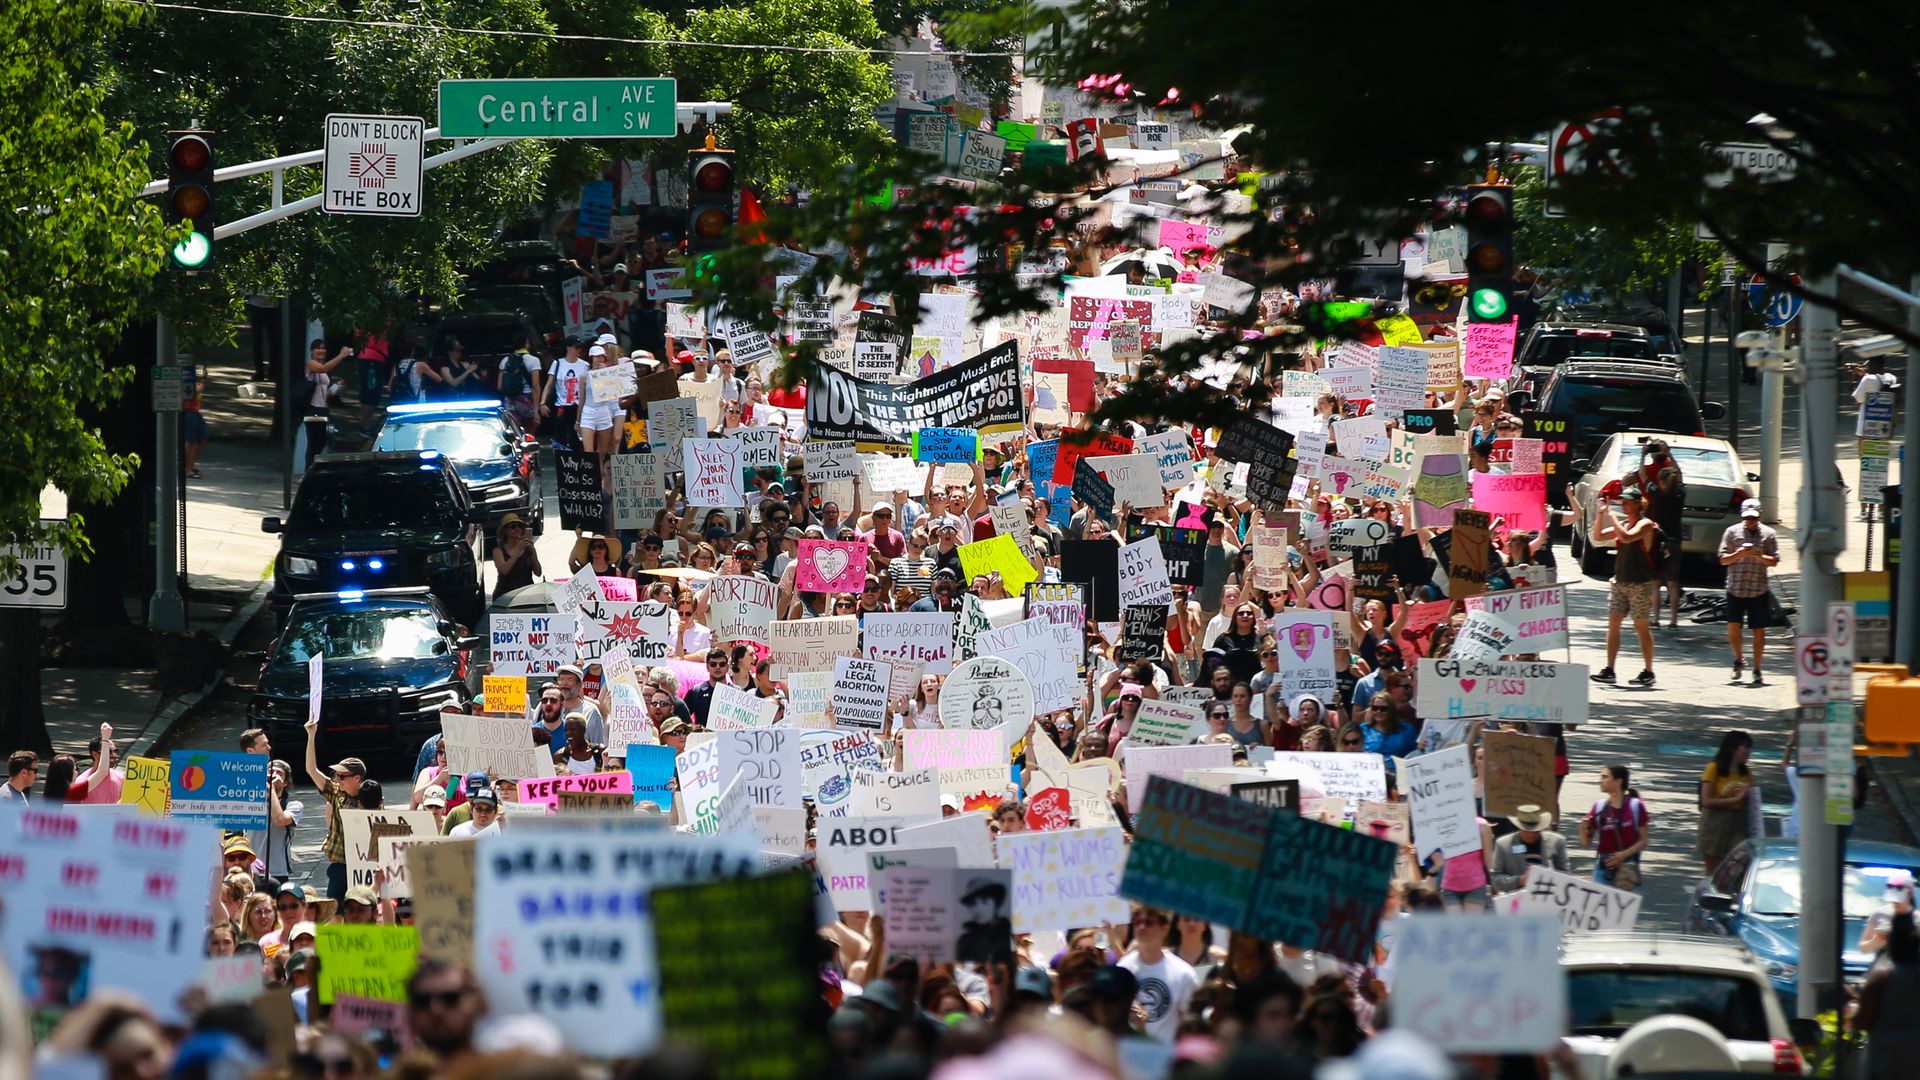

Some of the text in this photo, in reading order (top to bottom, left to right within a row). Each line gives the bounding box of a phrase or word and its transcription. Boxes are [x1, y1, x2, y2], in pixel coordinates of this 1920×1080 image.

[621, 85, 655, 104] AVE
[478, 94, 598, 124] Central
[624, 112, 651, 131] SW
[331, 121, 418, 141] DON'T BLOCK
[1141, 125, 1168, 133] DEFEND
[968, 131, 983, 144] WE
[1148, 133, 1162, 142] ROE
[970, 144, 1001, 160] SHALL
[332, 189, 412, 210] THE BOX
[1132, 190, 1145, 198] NO
[1086, 299, 1134, 309] SUGAR
[1162, 297, 1185, 308] Body
[812, 311, 829, 319] WON
[1085, 311, 1128, 319] SPICE
[734, 333, 765, 349] FIGHT FOR
[735, 340, 770, 357] SOCIALISM!
[824, 350, 845, 360] BODY
[858, 360, 894, 368] IS SEXIST!
[861, 353, 892, 361] SYSTEM
[859, 372, 878, 380] FIGHT
[865, 388, 888, 402] This
[892, 377, 958, 405] Nightmare
[960, 364, 988, 384] Must
[990, 349, 1014, 370] End:
[866, 369, 1017, 420] THE TRUMP/PENCE
[1346, 386, 1363, 394] LEGAL
[941, 388, 1015, 426] MUST GO!
[989, 411, 1020, 423] America!
[1407, 415, 1433, 426] PRO
[825, 427, 855, 439] Name of
[943, 429, 973, 437] KEMP
[1534, 420, 1566, 432] YOU
[732, 429, 779, 445] TRUST
[806, 443, 824, 453] KEEP
[561, 457, 594, 472] Why Are
[616, 455, 656, 465] WE NEED
[701, 454, 724, 464] KEEP
[625, 466, 634, 476] GET
[704, 464, 727, 473] YOUR
[807, 470, 856, 480] SAFE LEGAL
[1110, 466, 1130, 481] NOT
[563, 472, 594, 485] You So
[1161, 470, 1184, 483] RIGHTS
[559, 489, 601, 500] Obsessed
[564, 503, 602, 518] With Us?
[995, 507, 1015, 519] WE
[1456, 511, 1489, 530] NEVER
[10, 547, 54, 560] LIMIT
[1120, 546, 1141, 562] MY
[1362, 547, 1379, 561] MY
[1120, 557, 1152, 579] BODY
[1452, 565, 1487, 584] AGAIN
[4, 565, 57, 596] 35
[1361, 575, 1382, 586] MY
[711, 577, 775, 610] ABORTION
[1031, 584, 1078, 602] KEEP
[1122, 579, 1170, 603] POLITICAL
[738, 603, 748, 614] IS
[1492, 590, 1560, 613] MY FUTURE
[583, 601, 610, 620] We
[1128, 607, 1162, 621] TRANS
[532, 618, 550, 632] MY
[720, 617, 769, 641] healthcare
[775, 621, 852, 638] HEARTBEAT BILLS
[867, 623, 949, 637] KEEP ABORTION
[1125, 621, 1148, 635] MEN
[1518, 617, 1568, 638] CHOICE
[493, 632, 549, 645] BODY, NOT
[493, 650, 535, 662] POLITICAL
[607, 659, 629, 680] RIGHTS
[849, 661, 876, 672] SAFE,
[1296, 668, 1329, 678] ARE YOU
[1435, 661, 1556, 679] GA LAWMAKERS
[845, 671, 876, 682] LEGAL
[485, 685, 512, 693] PRIVACY
[834, 679, 885, 694] ABORTION
[1486, 679, 1526, 695] PUSSY
[486, 697, 507, 705] BODILY
[792, 687, 827, 701] MIGRANT
[833, 695, 883, 707] ON DEMAND
[721, 689, 764, 714] OUR BODIES
[717, 702, 760, 726] OUR MINDS
[843, 707, 882, 719] APOLOGIES!
[1155, 707, 1194, 720] Pro Choice
[479, 720, 530, 749] BODY
[735, 730, 785, 755] STOP
[801, 730, 871, 762] IS IT REALLY
[907, 731, 962, 753] GIRLS
[474, 747, 538, 778] CHOICE
[804, 742, 878, 770] about FETUSES
[126, 760, 166, 781] BUILD
[220, 761, 263, 772] Welcome
[738, 759, 782, 781] OLD
[237, 777, 246, 785] to
[854, 772, 875, 788] ANTI
[217, 785, 266, 802] Georgia
[527, 777, 617, 799] KEEP YOUR
[1411, 780, 1440, 802] NOT
[191, 802, 206, 812] body
[875, 797, 892, 811] IS
[1031, 792, 1059, 815] STOP
[1042, 807, 1062, 822] THE
[1061, 836, 1118, 871] WOMB
[1057, 873, 1119, 900] RULES
[1531, 872, 1637, 925] #STAY
